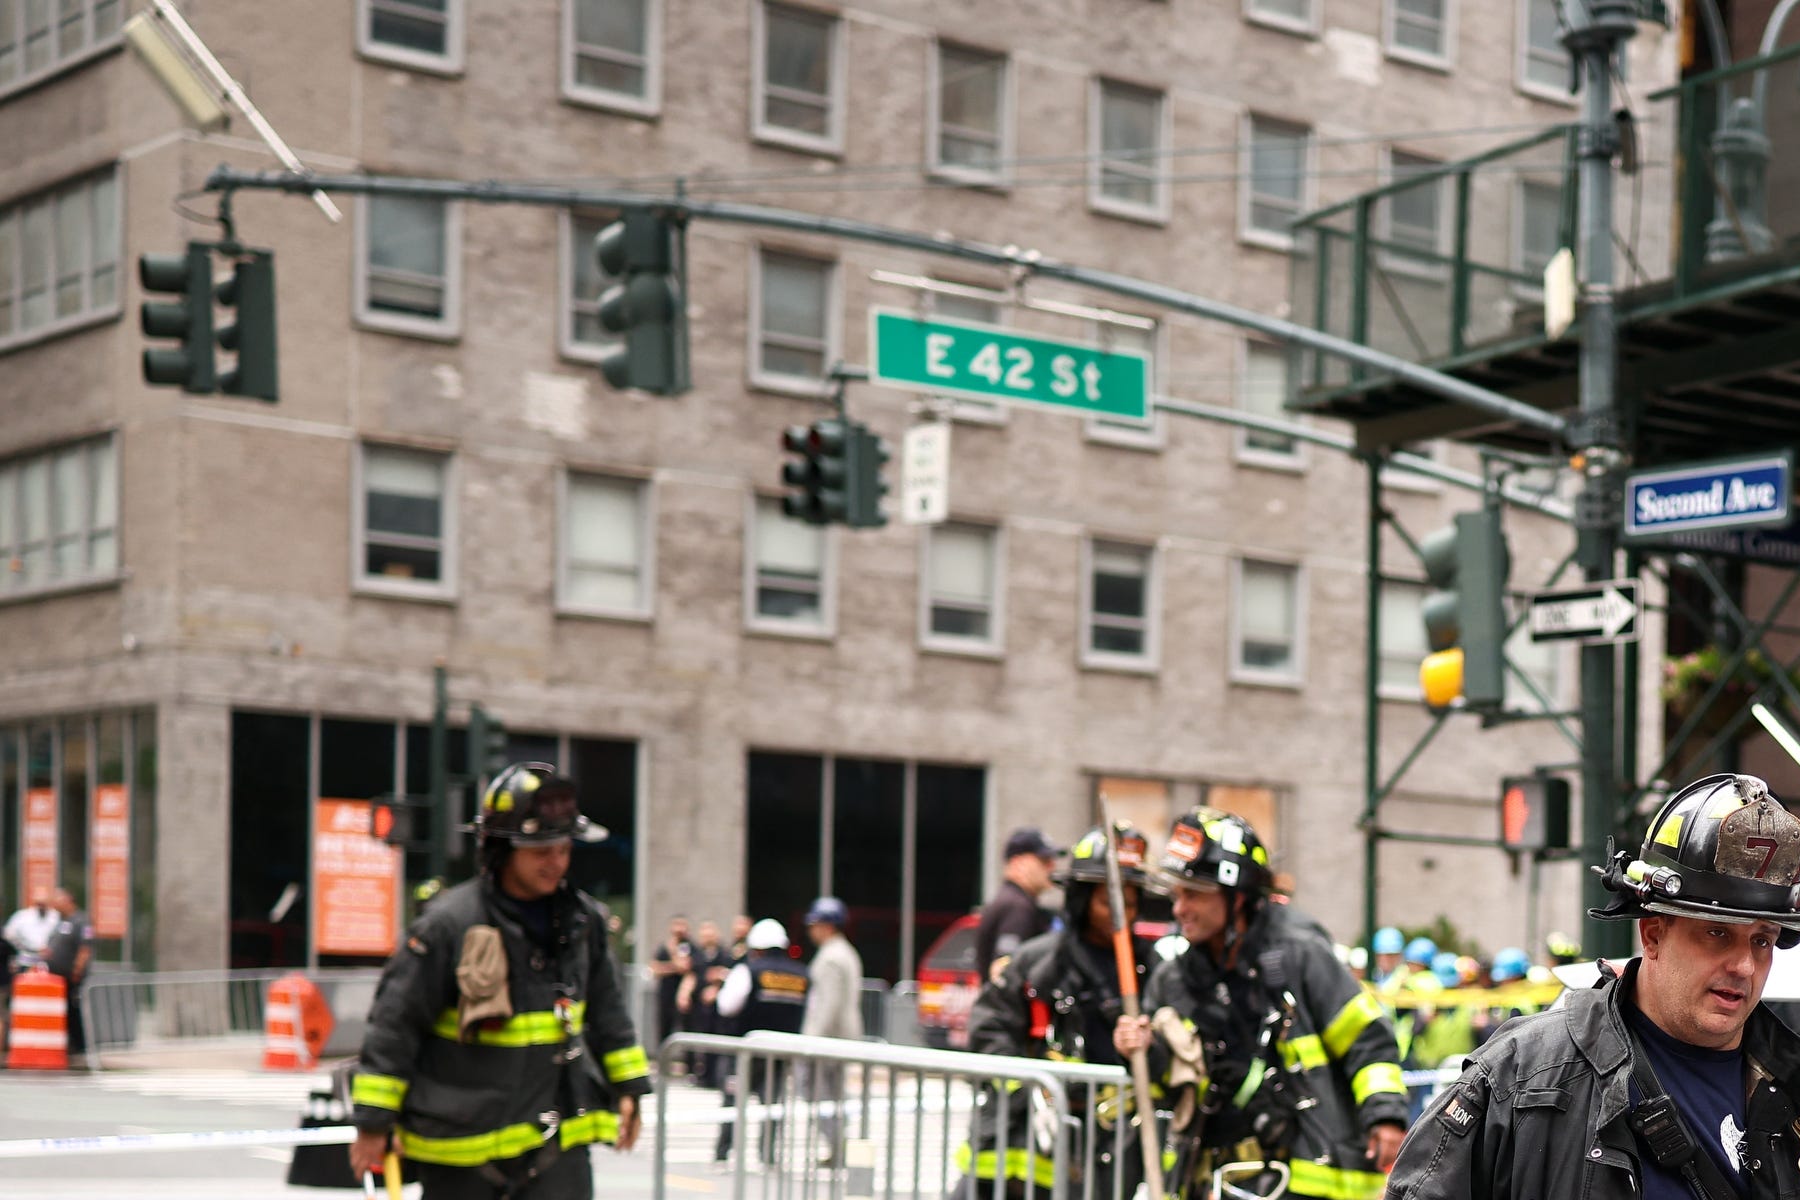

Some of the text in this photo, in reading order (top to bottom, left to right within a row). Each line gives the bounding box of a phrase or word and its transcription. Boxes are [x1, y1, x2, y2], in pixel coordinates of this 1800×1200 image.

[926, 333, 1102, 400] E 42 St
[1636, 476, 1776, 523] Second Ave
[1746, 836, 1779, 879] 7
[1450, 1104, 1472, 1127] LION
